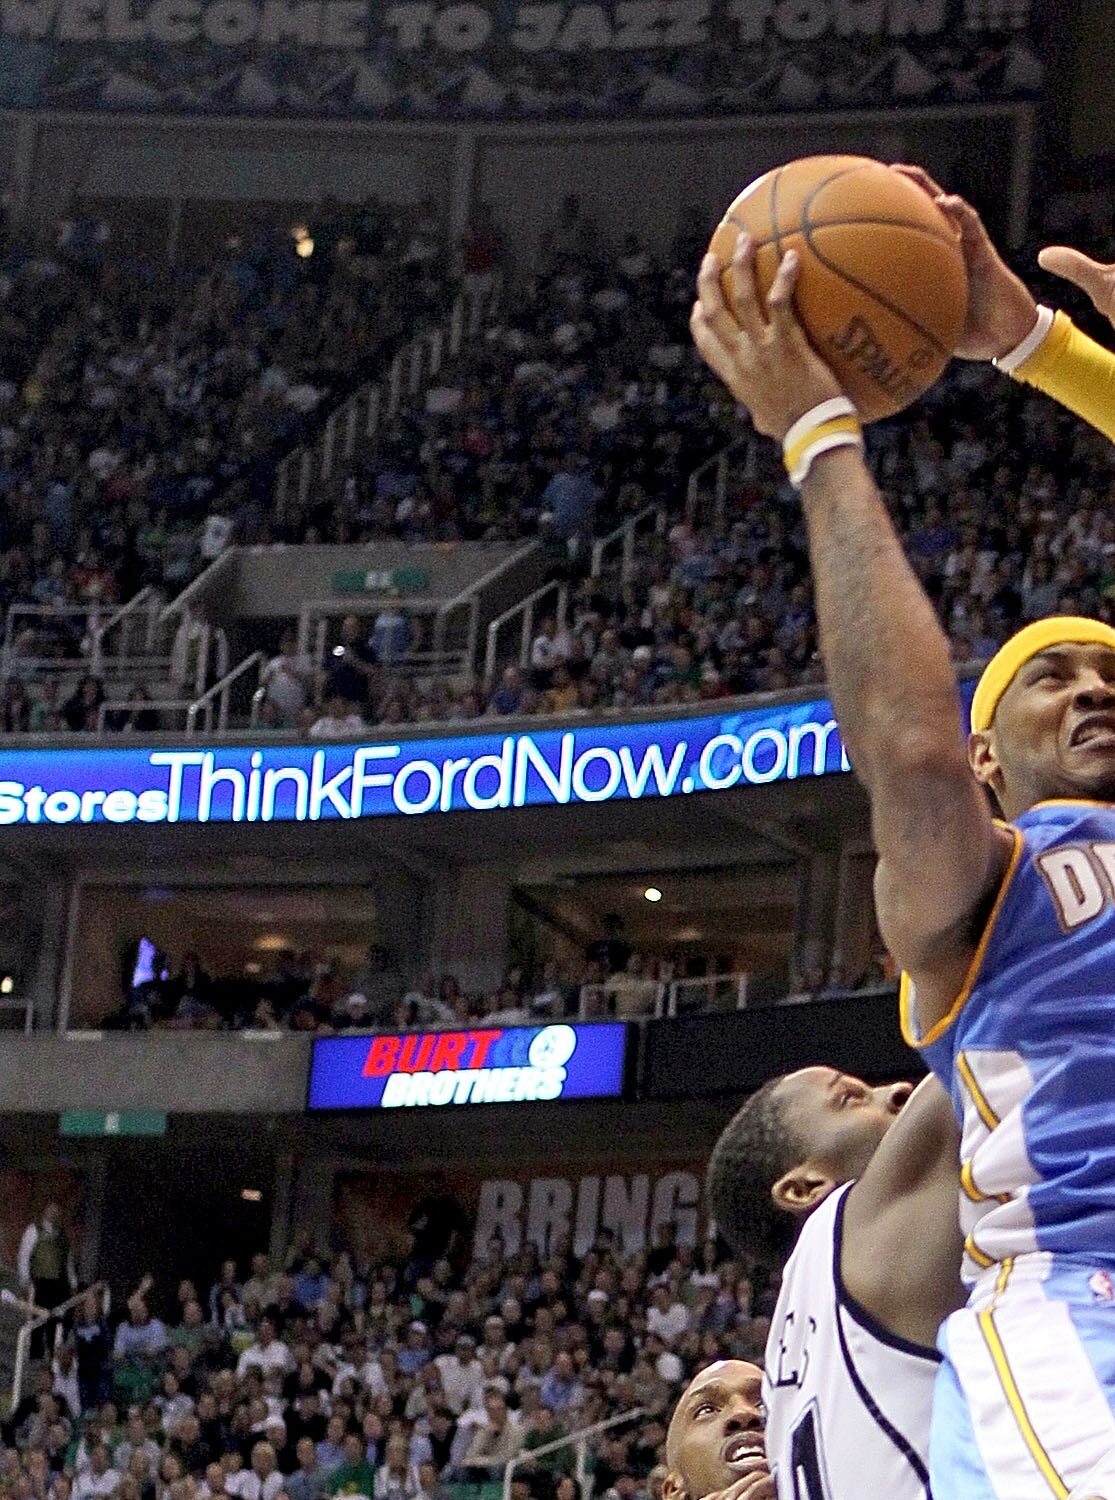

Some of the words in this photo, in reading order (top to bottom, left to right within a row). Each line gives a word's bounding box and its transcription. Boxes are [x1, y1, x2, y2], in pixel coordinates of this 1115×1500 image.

[1, 0, 369, 46] WELCOME
[387, 3, 494, 51] TO
[510, 2, 710, 51] JAZZ
[727, 0, 947, 41] TOWN
[0, 781, 168, 825] Stores
[149, 719, 851, 823] ThinkFordNow.com
[362, 1030, 502, 1077] BURT
[381, 1066, 567, 1108] BROTHERS
[472, 1171, 700, 1260] BRING
